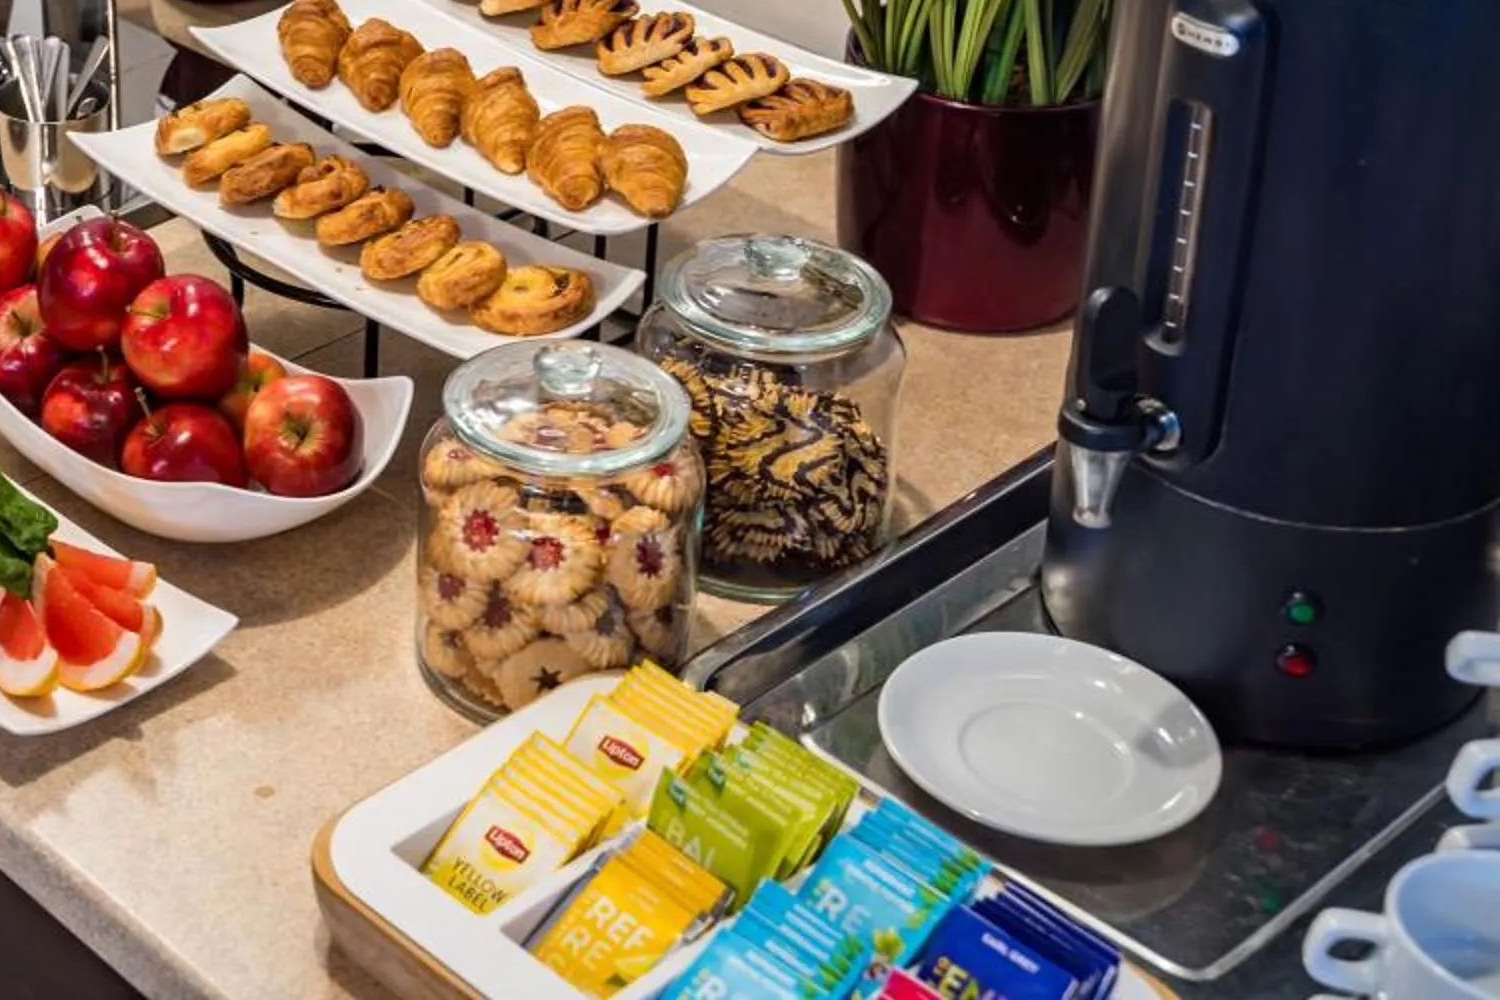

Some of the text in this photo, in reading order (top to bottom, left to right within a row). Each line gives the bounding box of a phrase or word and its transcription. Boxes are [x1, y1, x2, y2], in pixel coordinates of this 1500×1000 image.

[488, 826, 530, 862] Lipton
[448, 875, 489, 912] LABEL
[453, 857, 509, 903] YELLOW
